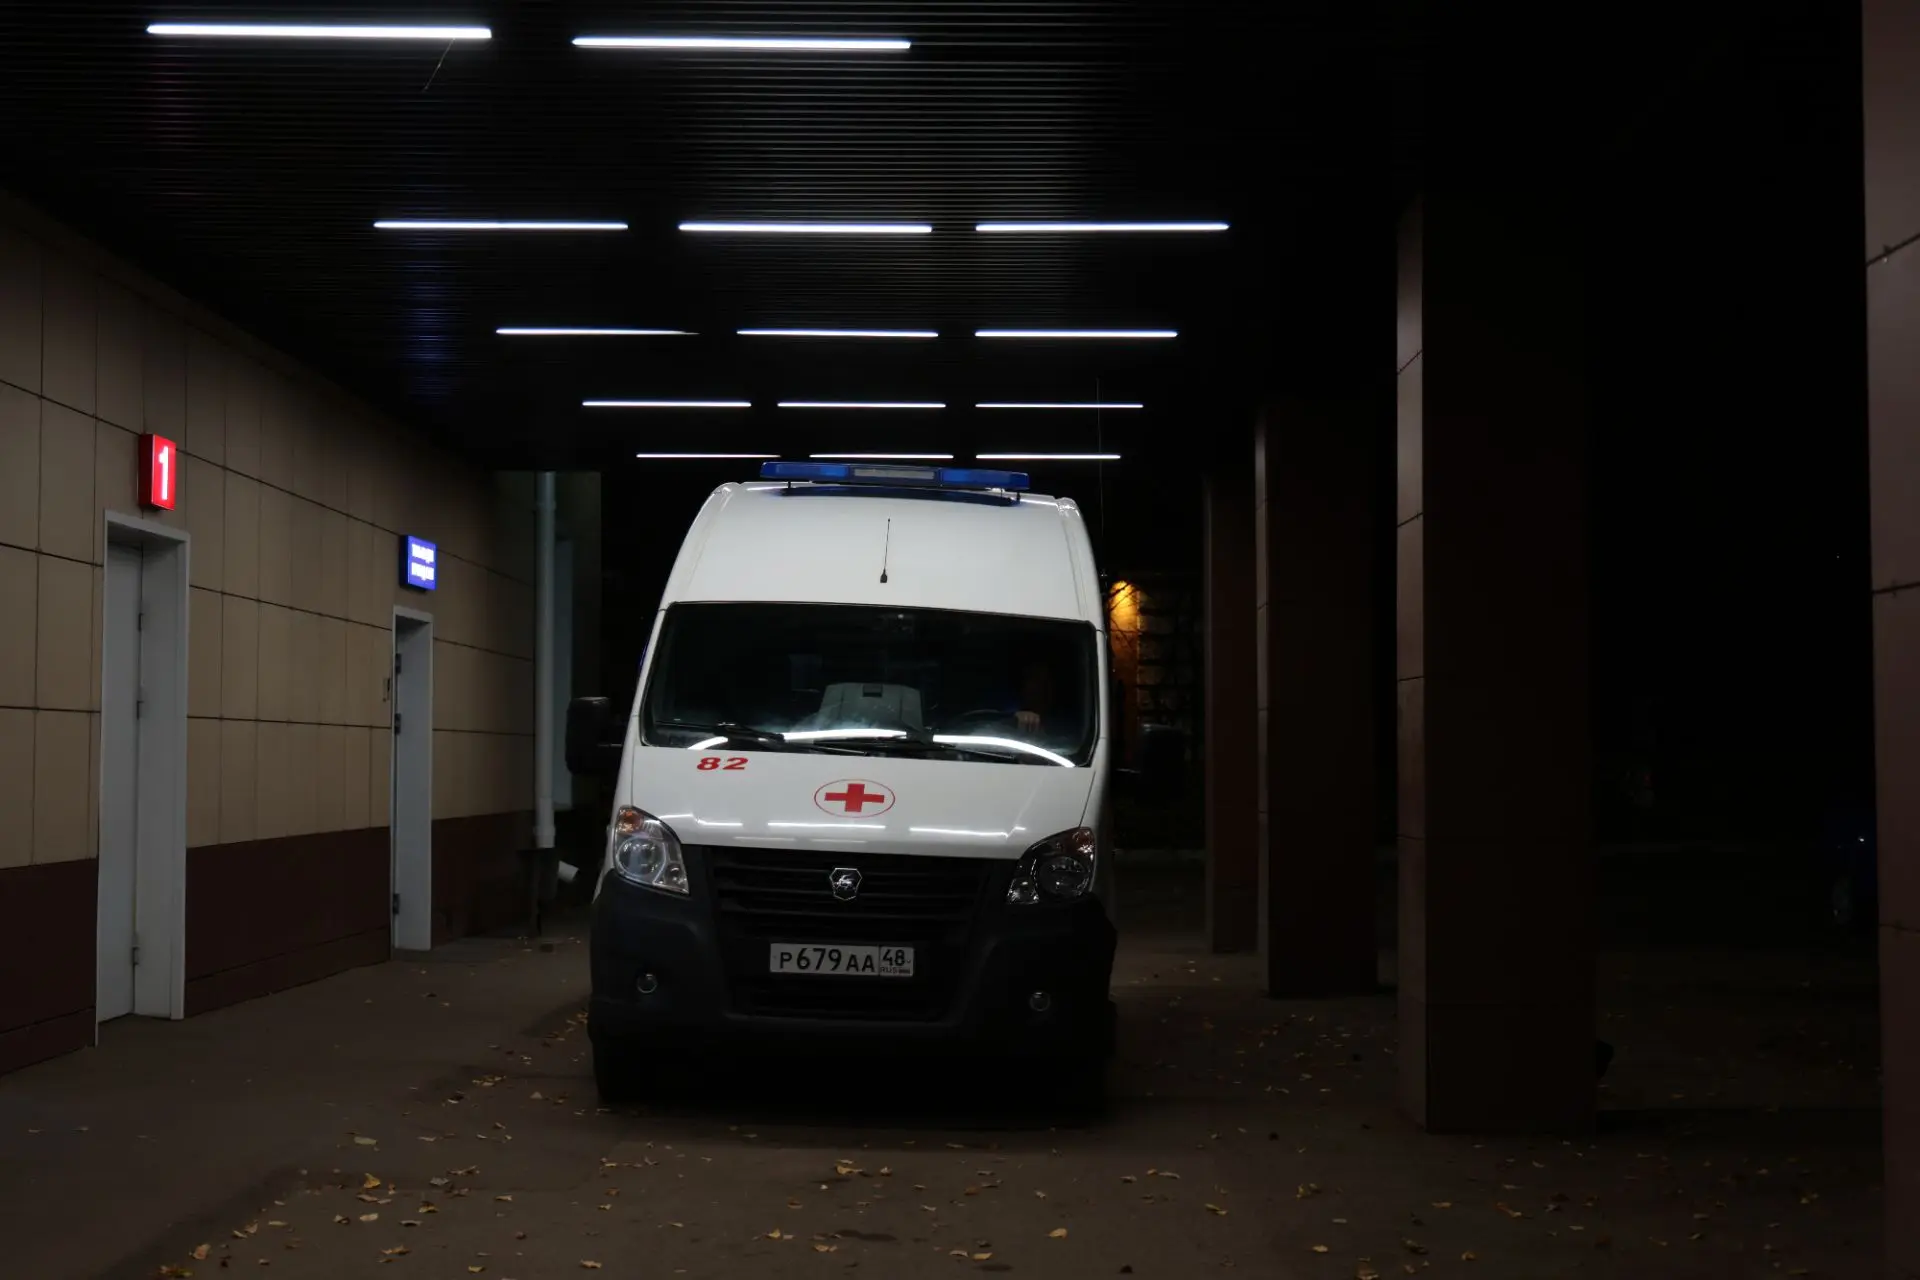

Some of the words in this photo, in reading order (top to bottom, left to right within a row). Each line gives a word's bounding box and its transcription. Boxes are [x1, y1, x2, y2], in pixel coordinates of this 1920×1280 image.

[158, 445, 169, 500] 1
[697, 757, 749, 771] 82
[882, 948, 906, 967] 48
